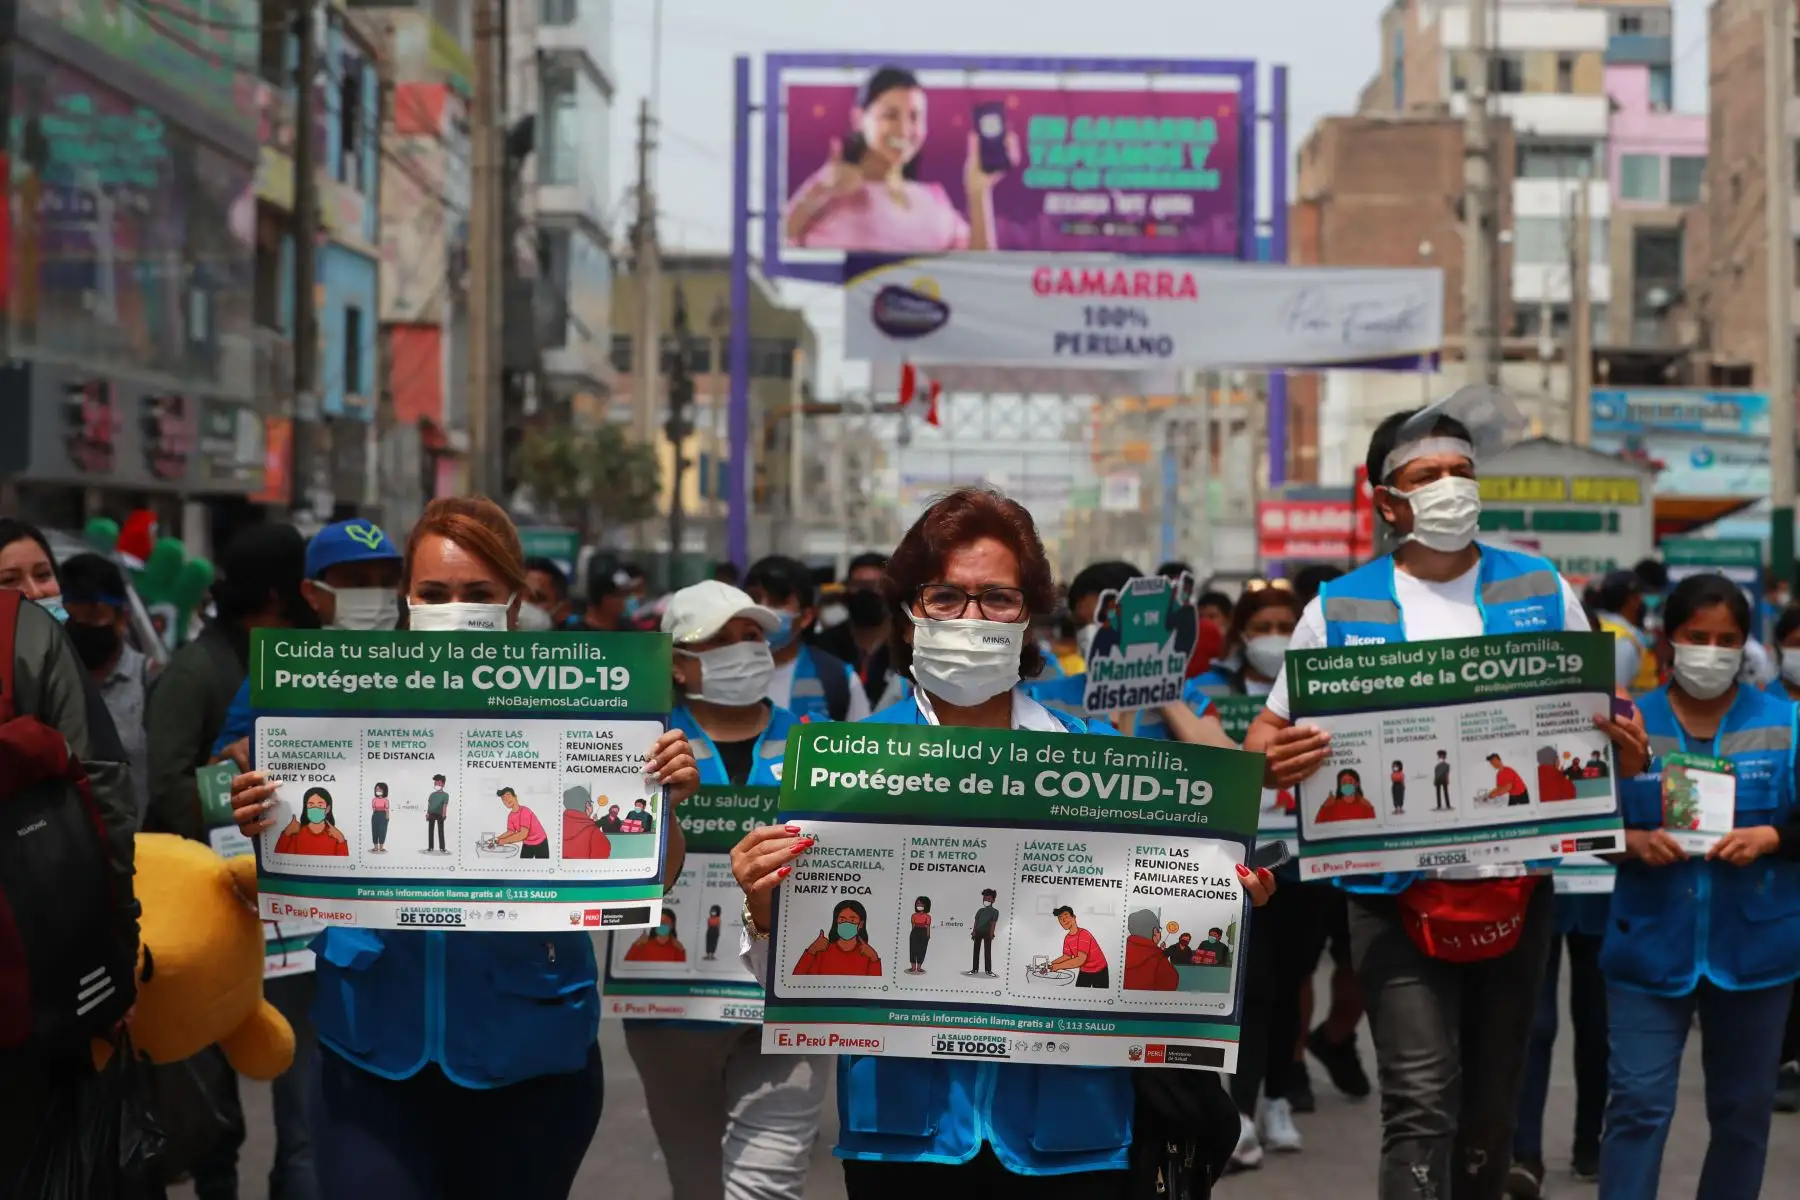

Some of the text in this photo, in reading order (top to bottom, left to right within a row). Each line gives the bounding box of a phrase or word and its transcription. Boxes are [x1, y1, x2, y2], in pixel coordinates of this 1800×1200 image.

[1032, 268, 1198, 300] GAMARRA
[1084, 306, 1148, 328] 100%
[1054, 333, 1173, 357] PERUANO
[1144, 612, 1159, 625] 1M
[982, 636, 1010, 645] MINSA
[275, 642, 606, 663] Cuida tu salud y la de tu familia.
[1306, 639, 1564, 671] Cuida tu salud y la de tu familia.
[1092, 655, 1184, 682] ¡Mantén tu
[275, 666, 630, 693] Protégete de la COVID-19
[1308, 654, 1583, 695] Protégete de la COVID-19
[1088, 678, 1182, 711] distancia!
[488, 696, 628, 708] #NoBajemosLaGuardia
[368, 727, 434, 737] MANTÉN MÁS
[467, 729, 502, 738] LÁVATE
[596, 731, 613, 739] LAS
[268, 740, 352, 748] CORRECTAMENTE
[566, 742, 623, 750] REUNIONES
[282, 752, 346, 760] MASCARILLA,
[368, 752, 435, 760] DE DISTANCIA
[507, 749, 539, 759] JABÓN
[566, 754, 622, 762] FAMILIARES
[813, 736, 1188, 772] Cuida tu salud y la de tu familia.
[467, 761, 556, 769] FRECUENTEMENTE
[268, 774, 336, 782] NARIZ Y BOCA
[810, 767, 1213, 806] Protégete de la COVID-19
[693, 794, 773, 811] tu salud y
[1050, 805, 1208, 824] #NoBajemosLaGuardia
[676, 815, 736, 834] égete
[912, 837, 987, 848] MANTÉN MÁS
[1024, 841, 1086, 852] LÁVATE LAS
[800, 848, 894, 858] ORRECTAMENTE
[910, 850, 977, 860] DE 1 METRO
[1136, 846, 1189, 858] EVITA LAS
[1023, 853, 1093, 864] MANOS CON
[1419, 854, 1468, 865] DE TODOS
[796, 860, 885, 871] LA MASCARILLA,
[910, 863, 986, 873] DE DISTANCIA
[1022, 864, 1103, 875] AGUA Y JABÓN
[1135, 859, 1199, 872] REUNIONES
[796, 872, 861, 882] CUBRIENDO
[1021, 876, 1123, 889] FRECUENTEMENTE
[1134, 872, 1231, 887] FAMILIARES Y LAS
[358, 888, 375, 896] Para
[377, 889, 393, 897] más
[396, 888, 444, 898] información
[447, 889, 469, 898] llama
[471, 890, 493, 899] gratis
[495, 890, 502, 898] al
[795, 886, 872, 895] NARIZ Y BOCA
[1133, 887, 1237, 900] AGLOMERACIONES
[401, 914, 462, 924] DE TODOS
[889, 1012, 908, 1021] Para
[912, 1013, 930, 1022] más
[933, 1014, 987, 1024] información
[990, 1018, 1016, 1027] llama
[1018, 1020, 1042, 1029] gratis
[1065, 1021, 1083, 1030] 113
[1085, 1022, 1115, 1031] SALUD
[974, 1034, 1006, 1043] DEPENDE
[936, 1041, 1006, 1054] DE TODOS
